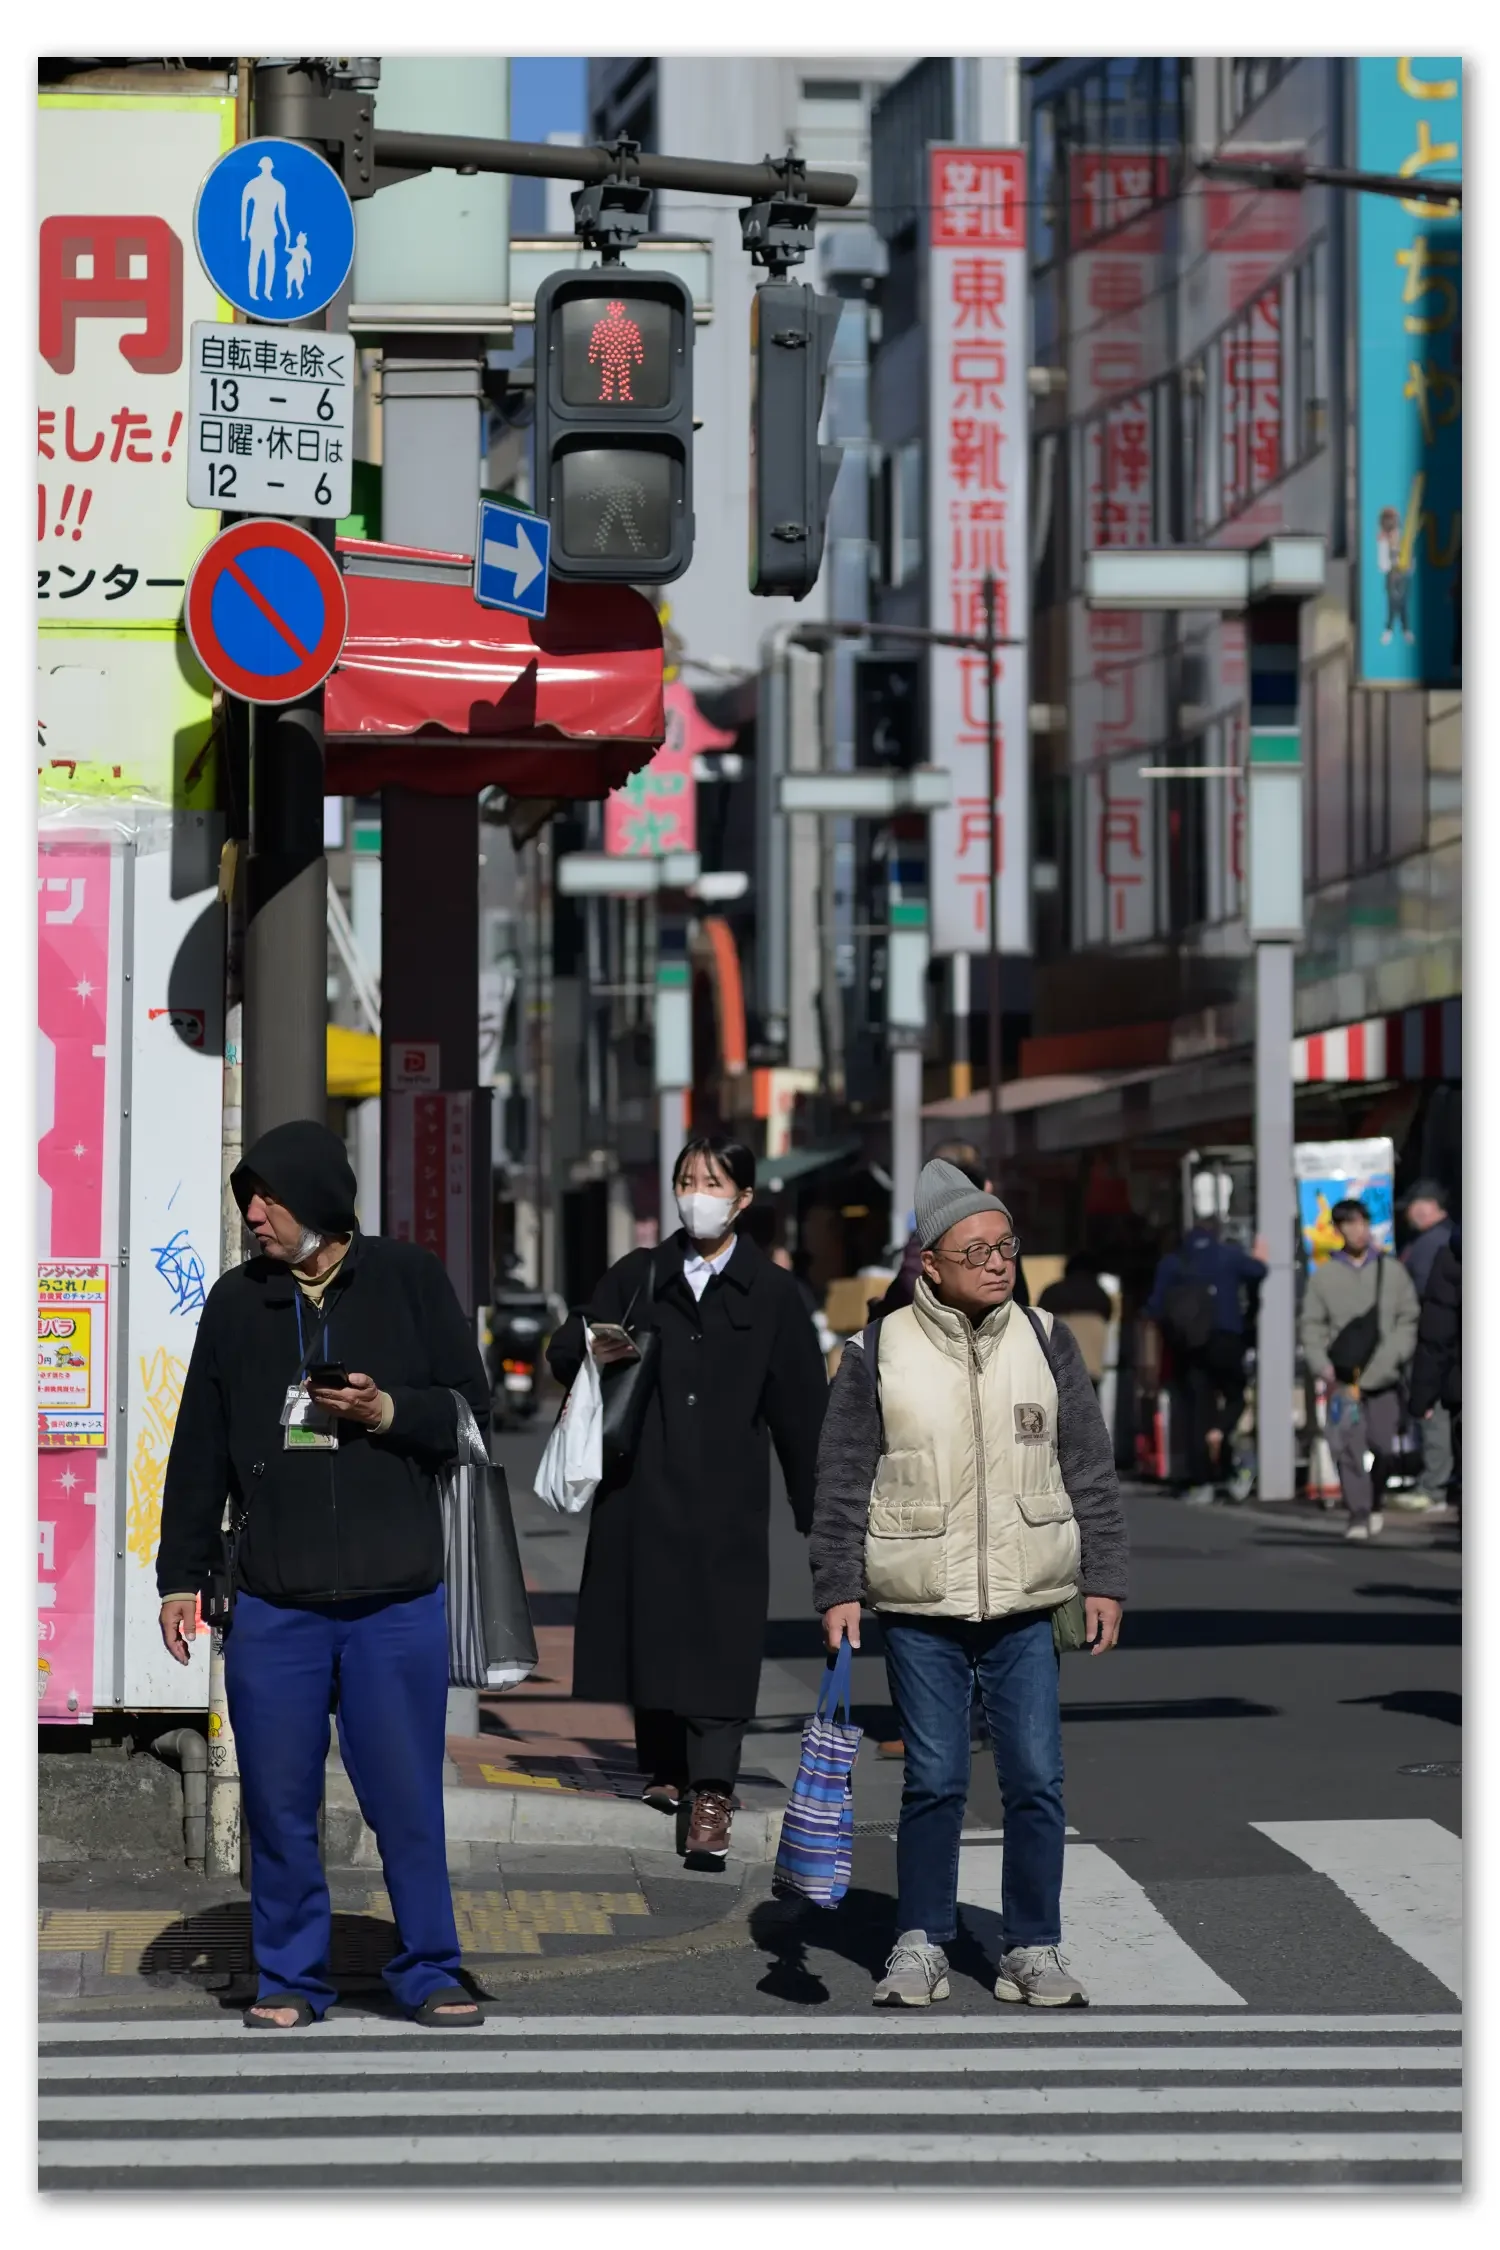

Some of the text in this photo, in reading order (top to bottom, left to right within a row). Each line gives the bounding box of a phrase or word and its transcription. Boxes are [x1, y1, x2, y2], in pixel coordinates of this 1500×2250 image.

[39, 215, 183, 374] 円
[202, 335, 344, 380] 自転車を除く
[210, 378, 239, 412] 13
[316, 388, 334, 421] 6
[200, 421, 343, 464] 日曜・休日は
[207, 464, 237, 499] 12
[314, 473, 332, 505] 6
